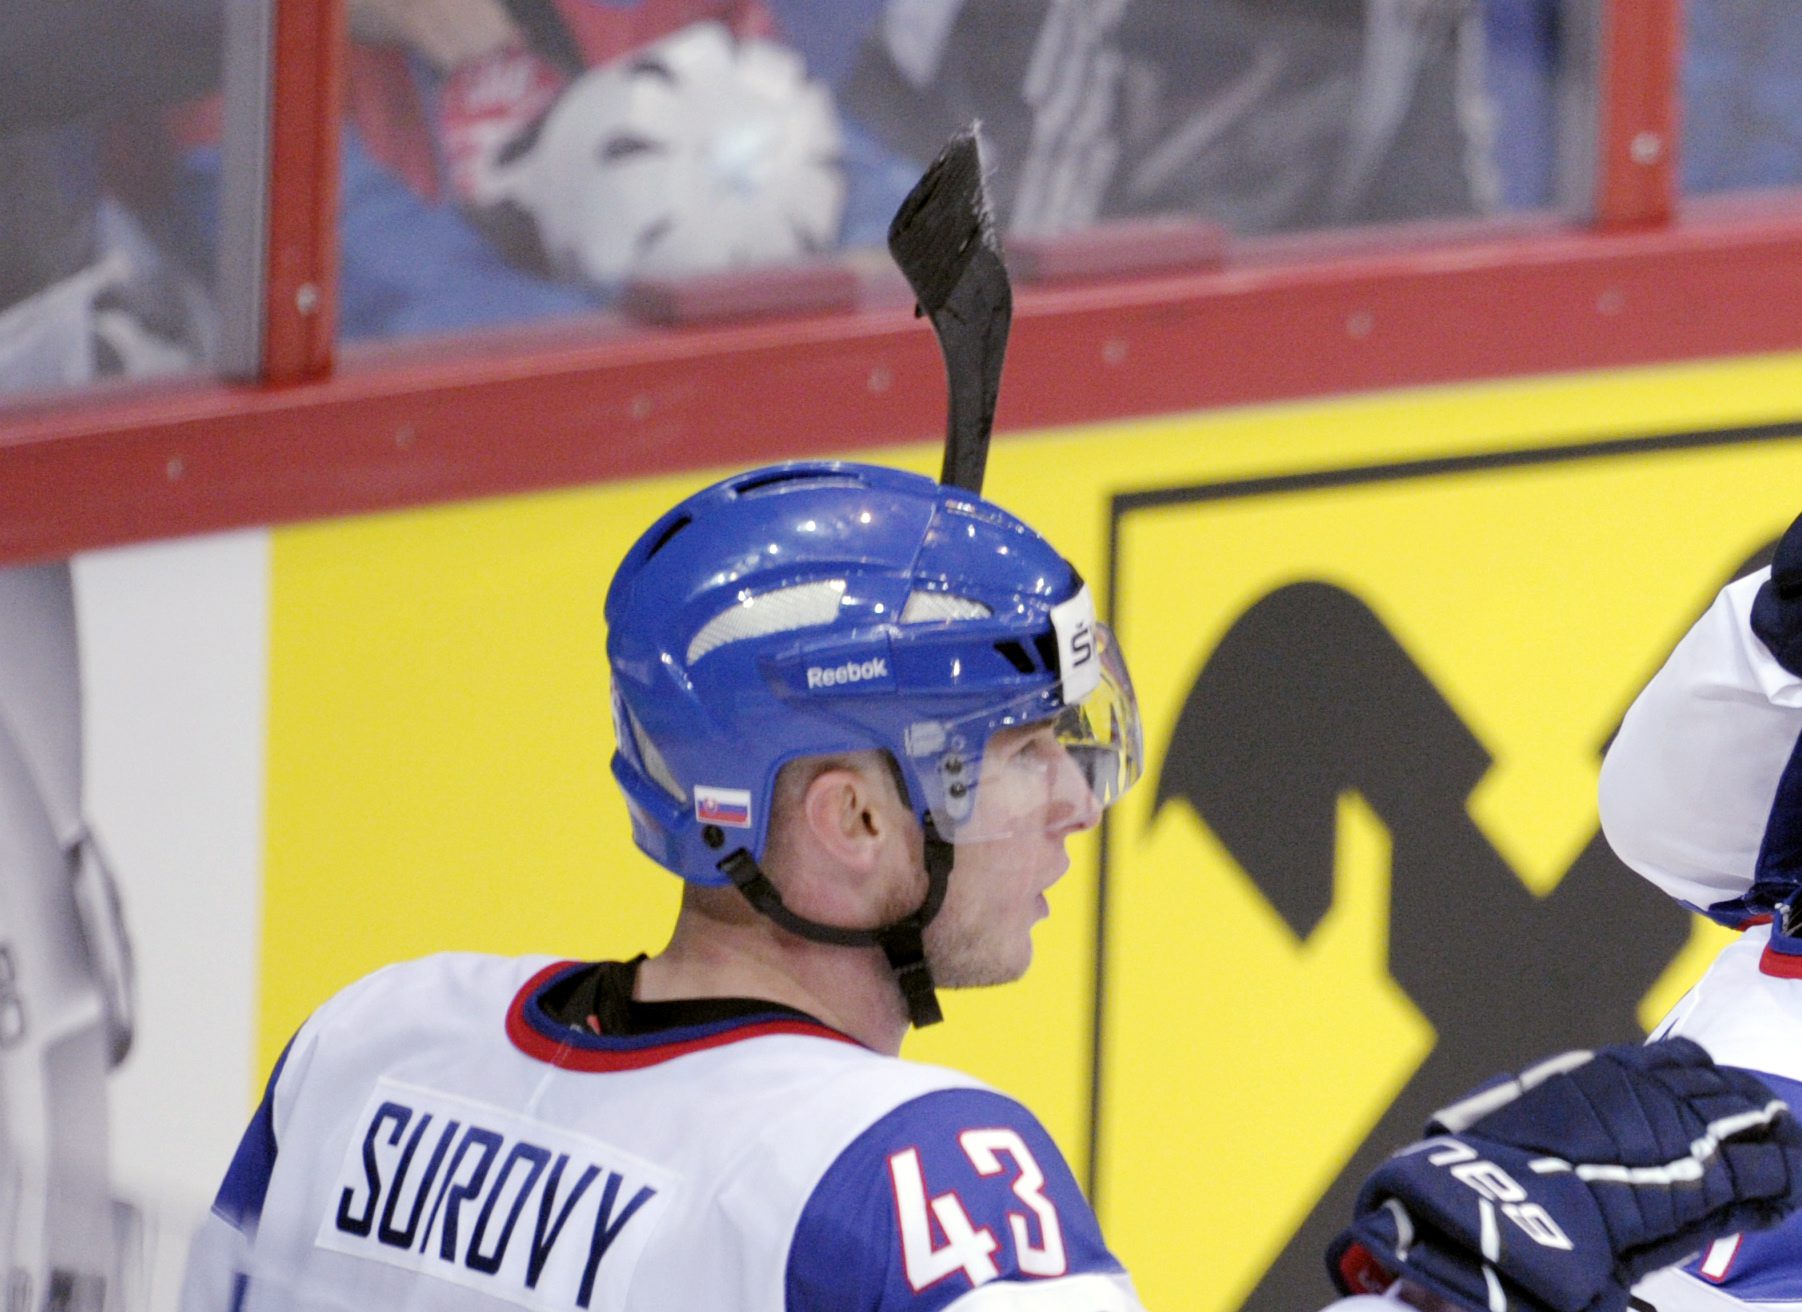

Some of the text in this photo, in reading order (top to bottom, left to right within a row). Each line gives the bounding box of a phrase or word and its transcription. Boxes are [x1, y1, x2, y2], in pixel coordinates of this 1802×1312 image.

[807, 658, 888, 690] Reebok
[335, 1101, 656, 1310] SUROVY
[888, 1127, 1069, 1294] 43
